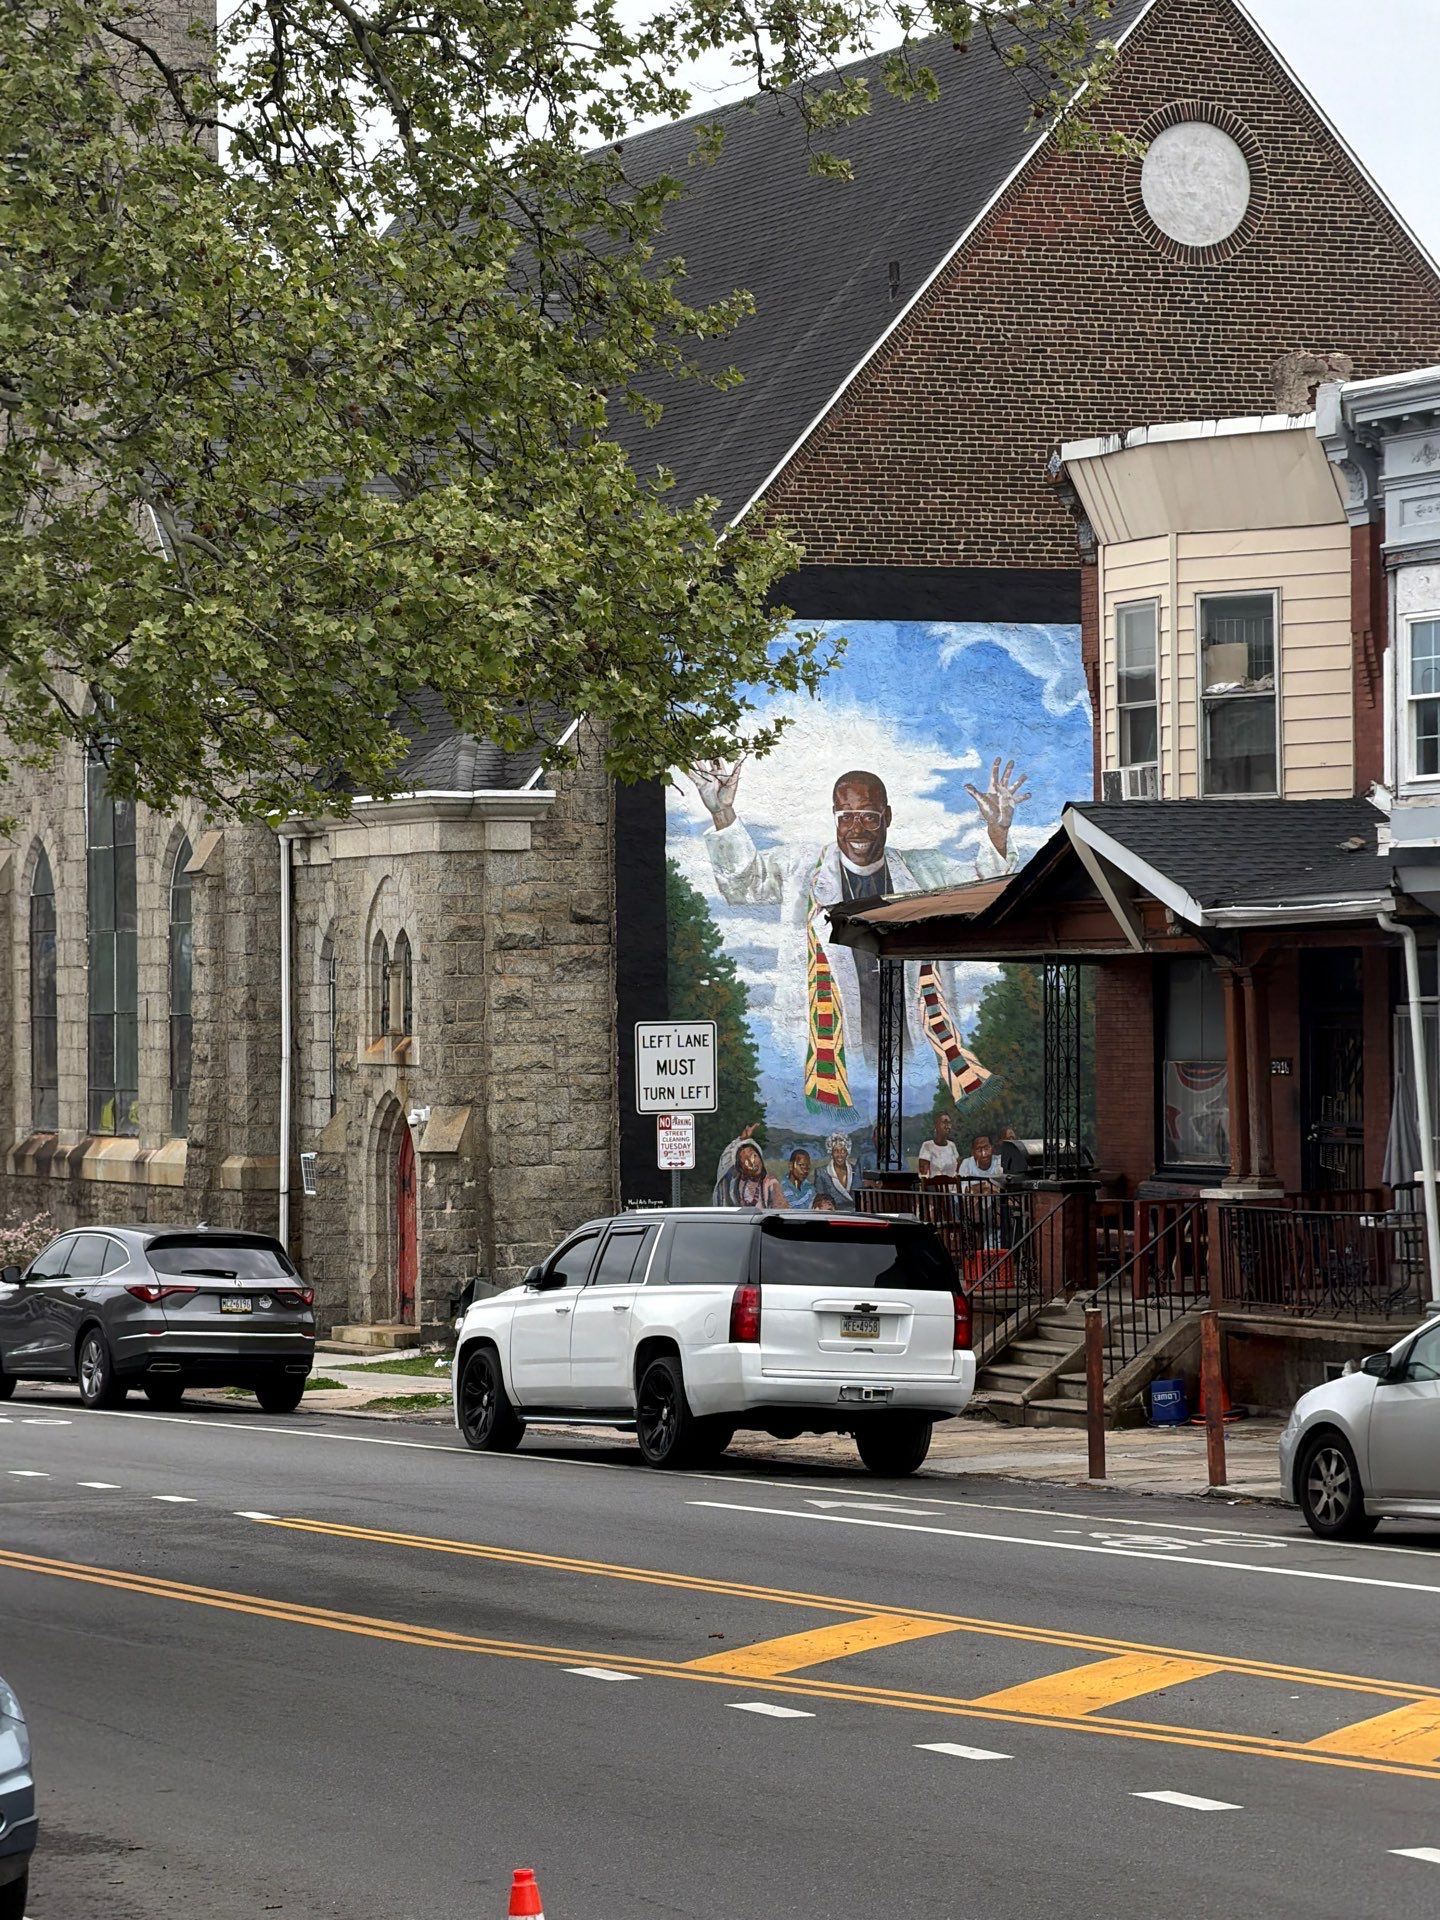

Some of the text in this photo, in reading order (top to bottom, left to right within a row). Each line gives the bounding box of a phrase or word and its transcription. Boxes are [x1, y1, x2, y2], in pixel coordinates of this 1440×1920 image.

[642, 1034, 709, 1048] LEFT LANE
[656, 1058, 696, 1076] MUST
[643, 1086, 710, 1100] TURN LEFT
[659, 1116, 691, 1128] NO PARKING
